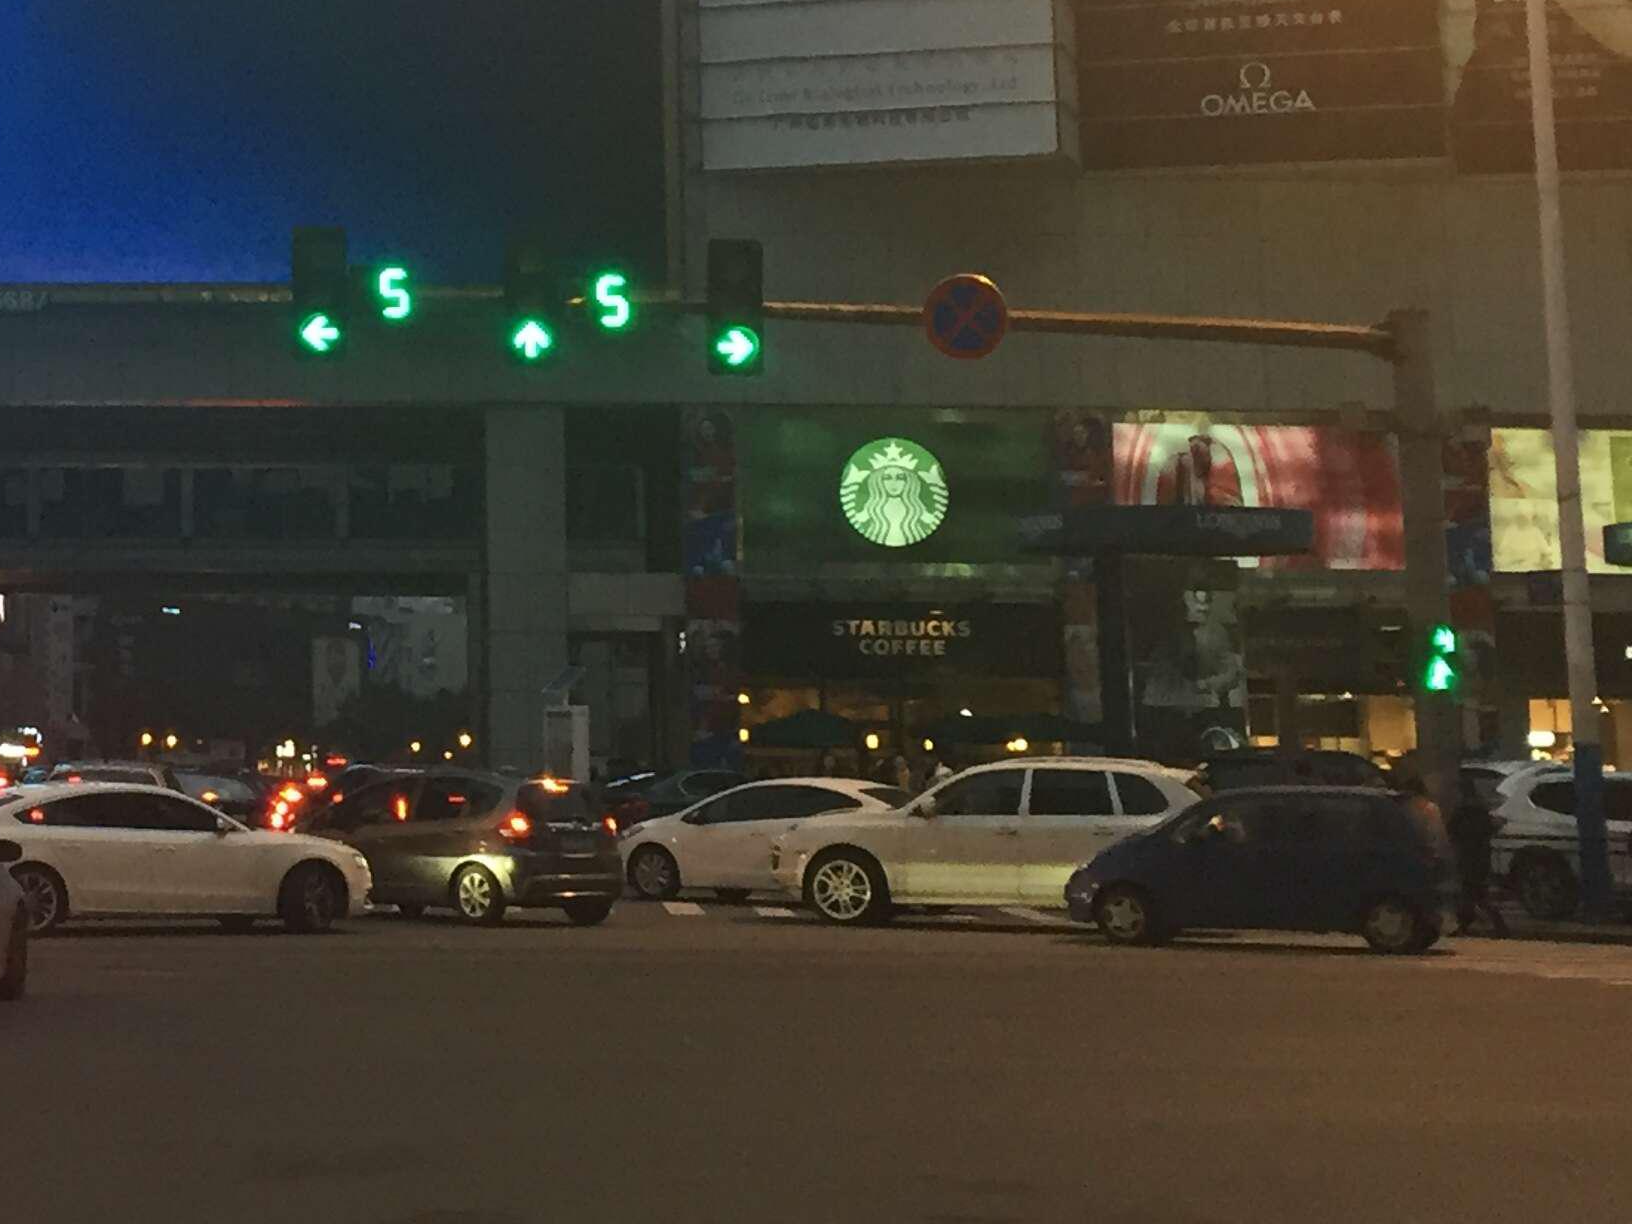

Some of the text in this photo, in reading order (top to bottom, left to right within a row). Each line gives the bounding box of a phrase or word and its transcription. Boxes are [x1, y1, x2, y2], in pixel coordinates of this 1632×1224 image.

[1200, 89, 1317, 117] OMEGA
[832, 619, 972, 638] STARBUCKS
[858, 638, 947, 657] COFFEE
